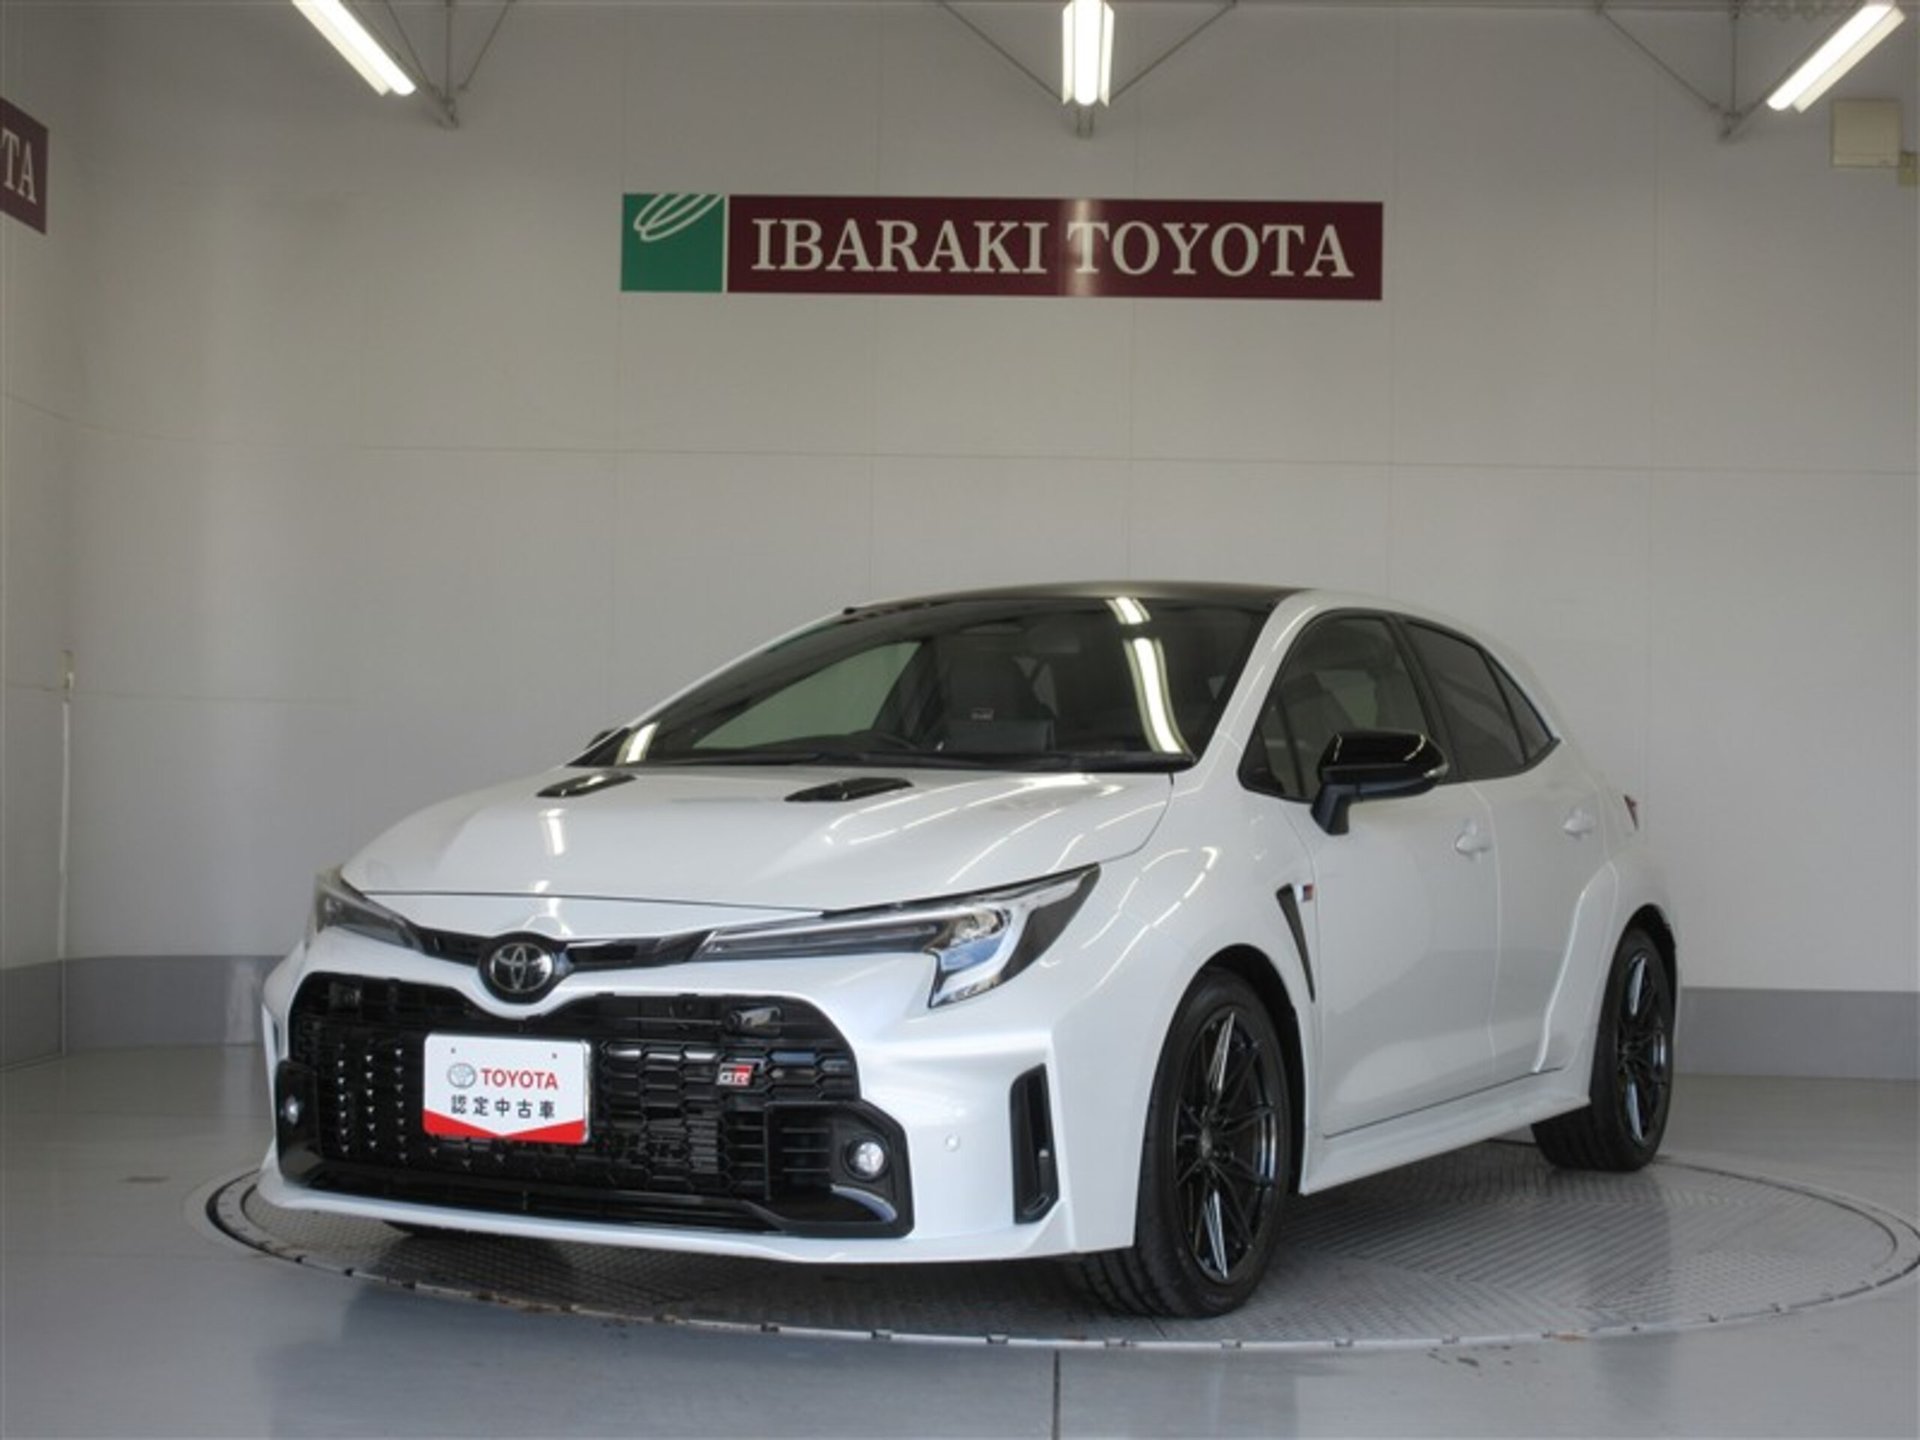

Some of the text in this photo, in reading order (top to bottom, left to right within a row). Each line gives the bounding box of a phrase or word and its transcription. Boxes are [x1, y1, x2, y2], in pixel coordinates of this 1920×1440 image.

[751, 218, 1354, 277] IBARAKI TOYOTA
[481, 1068, 558, 1090] TOYOTA
[451, 1095, 555, 1119] 認定中古車
